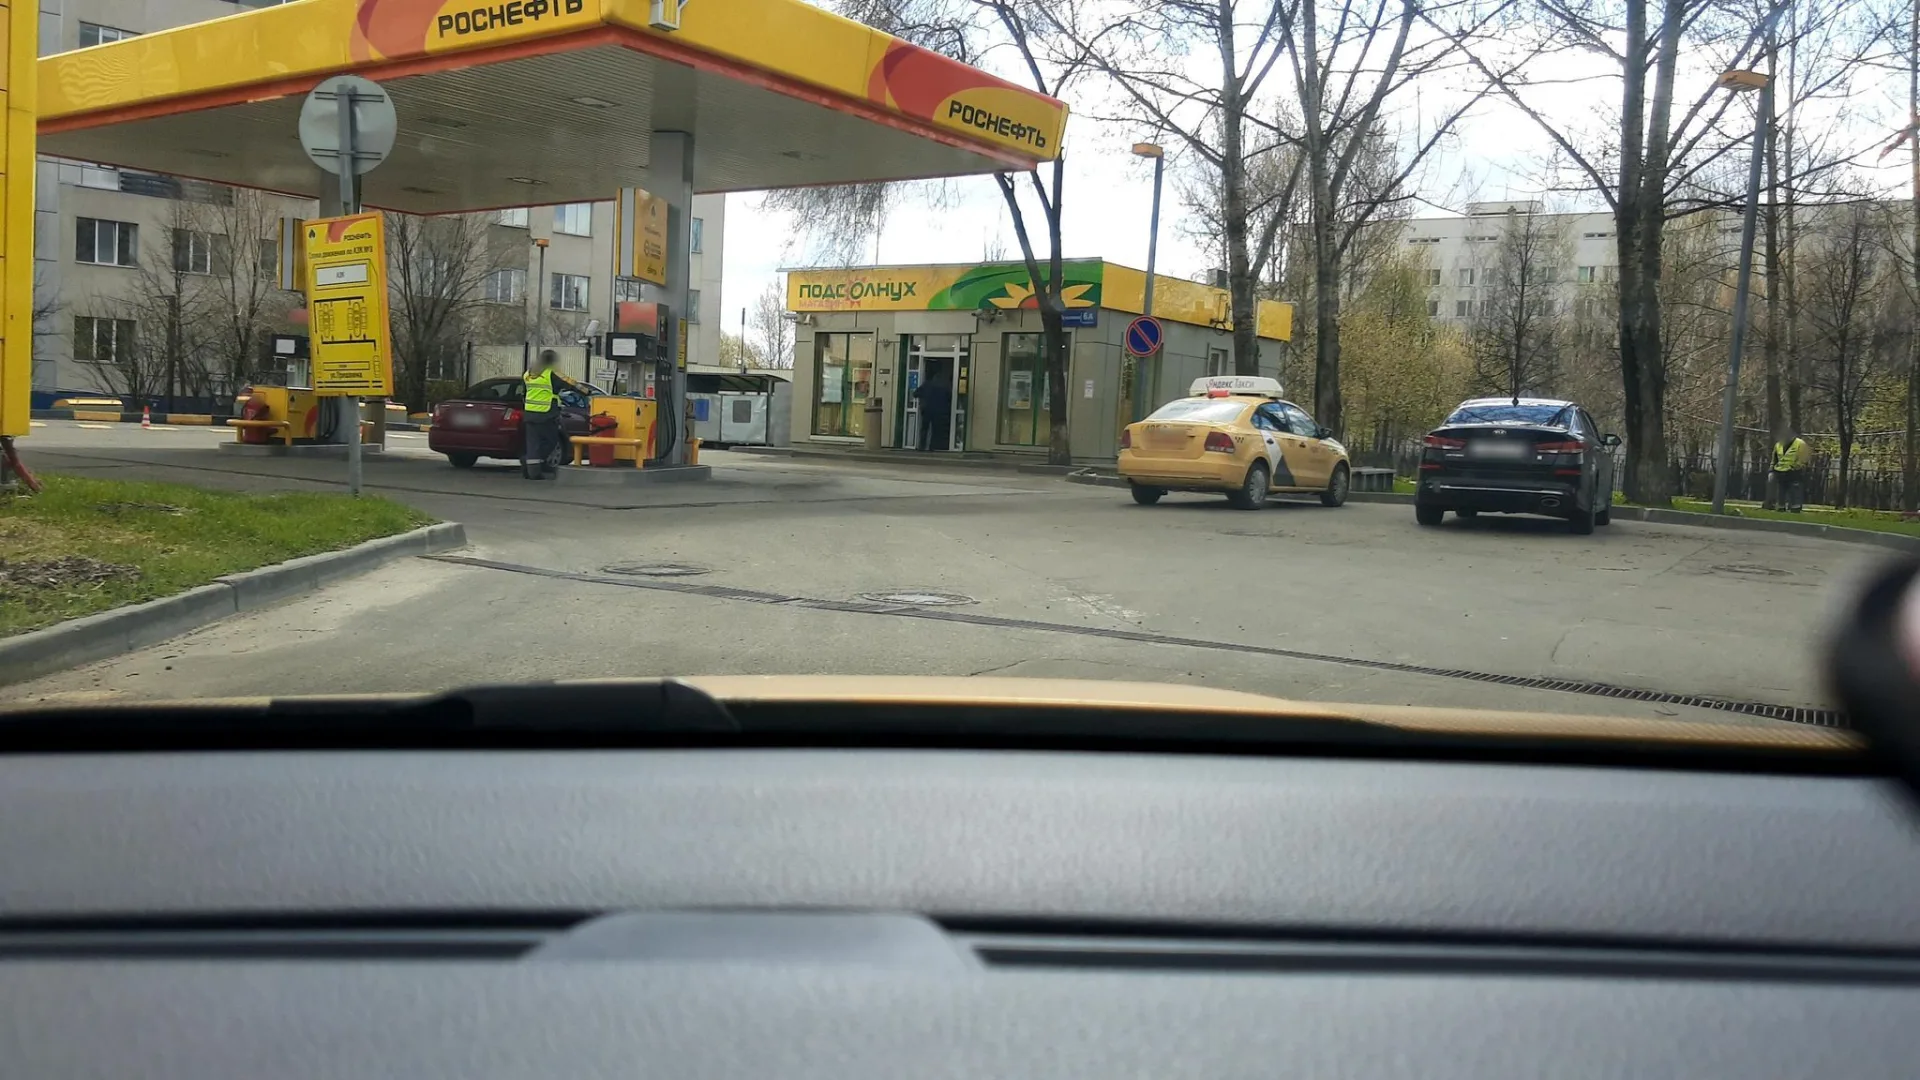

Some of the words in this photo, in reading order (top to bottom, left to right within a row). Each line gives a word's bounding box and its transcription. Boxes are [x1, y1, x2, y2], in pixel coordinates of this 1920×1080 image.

[437, 0, 583, 38] РОСНЕФТЬ
[948, 100, 1046, 148] РОСНЕФТЬ
[343, 232, 372, 241] РОСНЕФТЬ
[799, 281, 917, 302] ПОДСОЛНУХ
